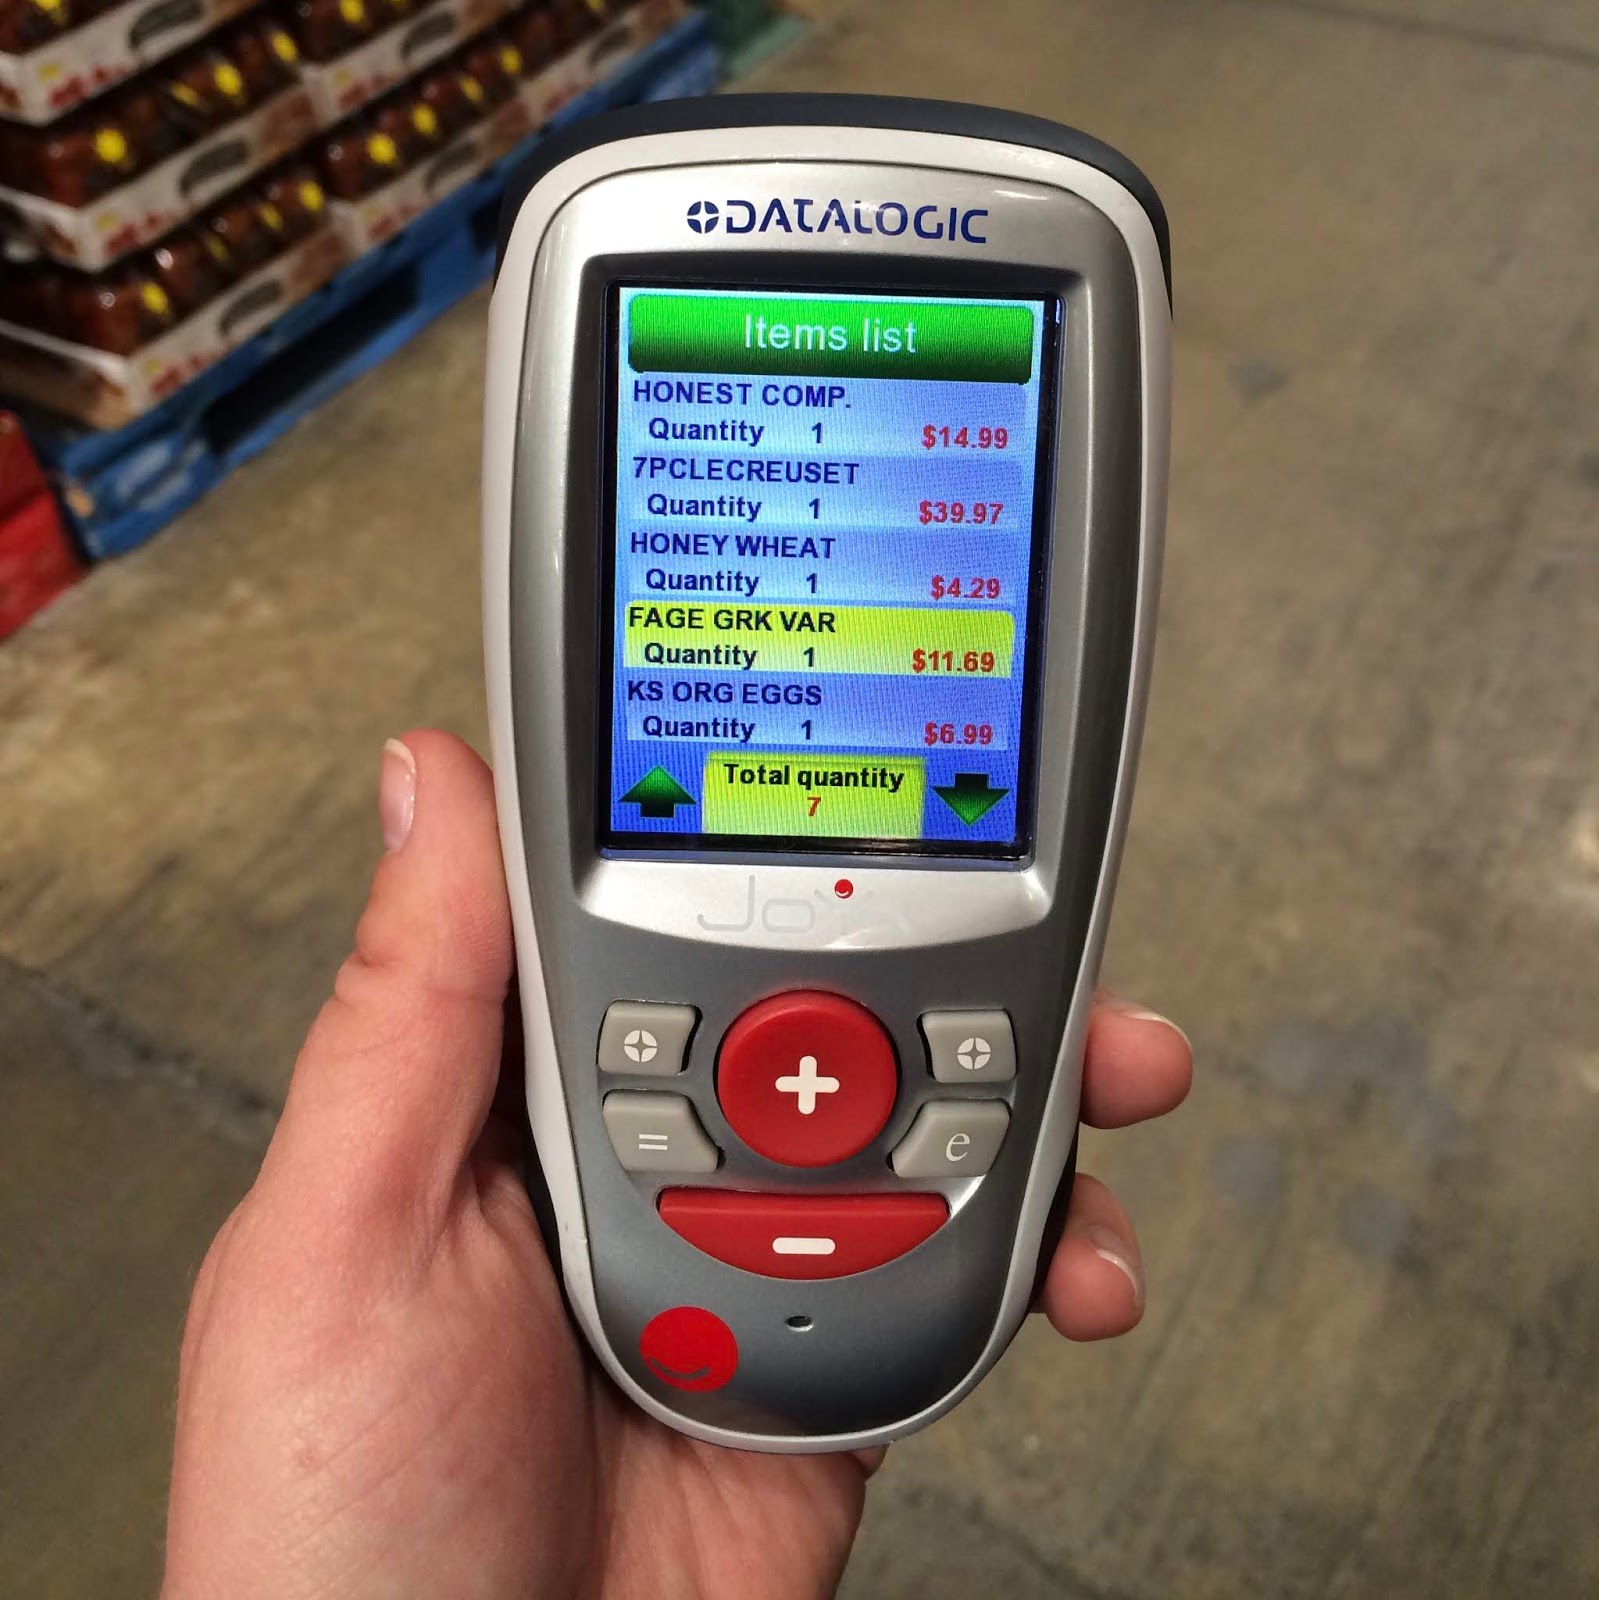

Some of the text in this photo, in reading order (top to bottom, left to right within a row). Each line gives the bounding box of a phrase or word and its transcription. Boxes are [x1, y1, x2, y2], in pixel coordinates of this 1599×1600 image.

[726, 199, 989, 243] DATALOGIC
[744, 314, 918, 354] Items list
[634, 380, 851, 410] HONEST COMP.
[649, 417, 1008, 450] Quantity 1 $14.99
[633, 456, 860, 485] 7PCLECREUSET
[647, 492, 1004, 525] Quantity 1 $39.97
[630, 532, 836, 559] HONEY WHEAT
[645, 568, 1001, 600] Quantity 1 $4.29
[628, 606, 836, 633] FAGE GRK VAR
[644, 642, 995, 673] Quantity 1 $11.69
[628, 679, 823, 706] KS ORG EGGS
[643, 716, 993, 747] Quantity 1 $6.99
[724, 762, 904, 793] Total quantity
[807, 796, 822, 817] 7
